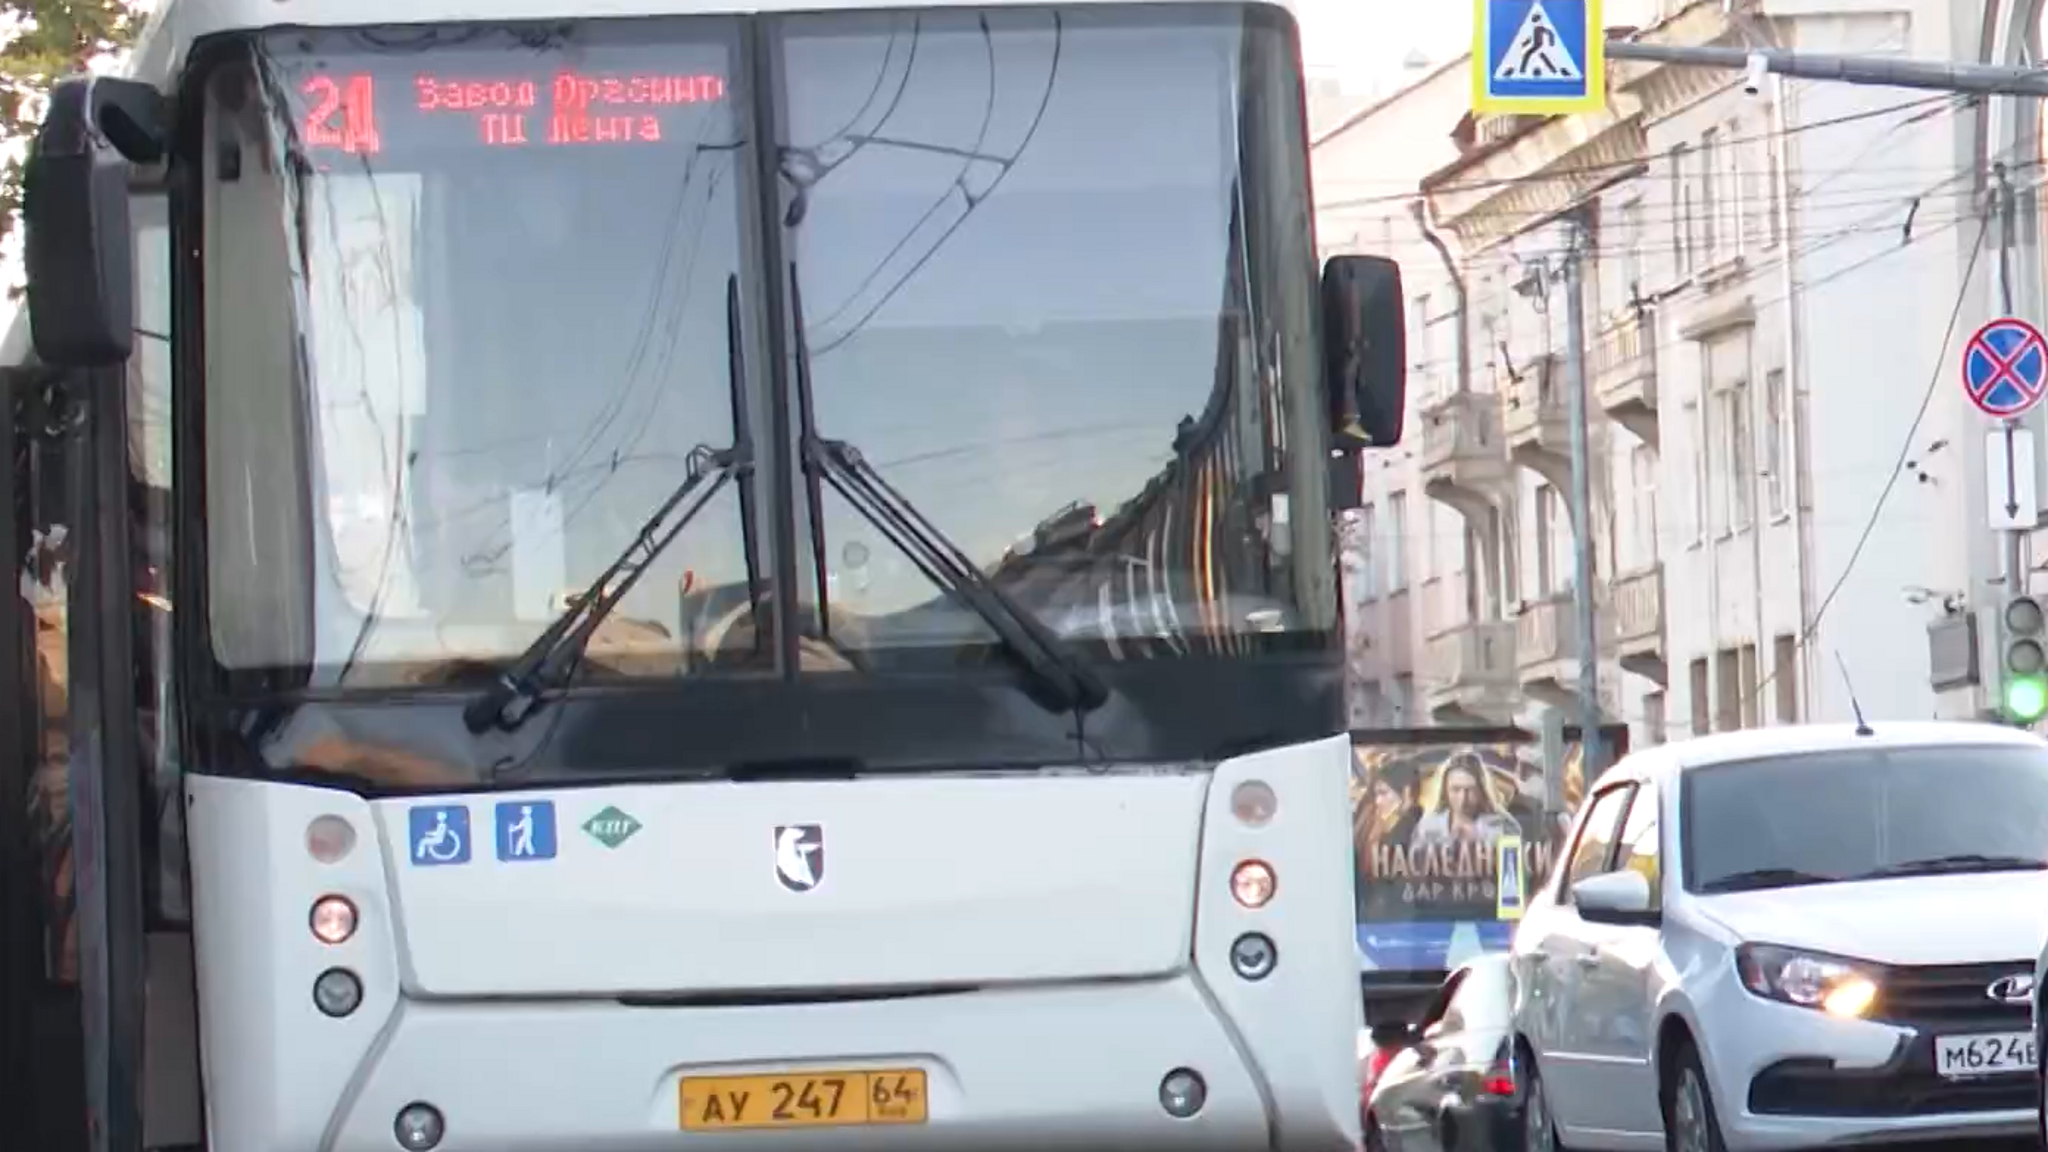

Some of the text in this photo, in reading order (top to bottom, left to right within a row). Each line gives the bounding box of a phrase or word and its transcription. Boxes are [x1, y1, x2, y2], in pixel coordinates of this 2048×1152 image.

[414, 76, 537, 109] Завод
[481, 113, 661, 144] ТЦ Лента
[1371, 840, 1553, 878] НАСЛЕДНКИ
[1402, 882, 1444, 902] ДАР
[702, 1076, 911, 1124] АУ 247 64
